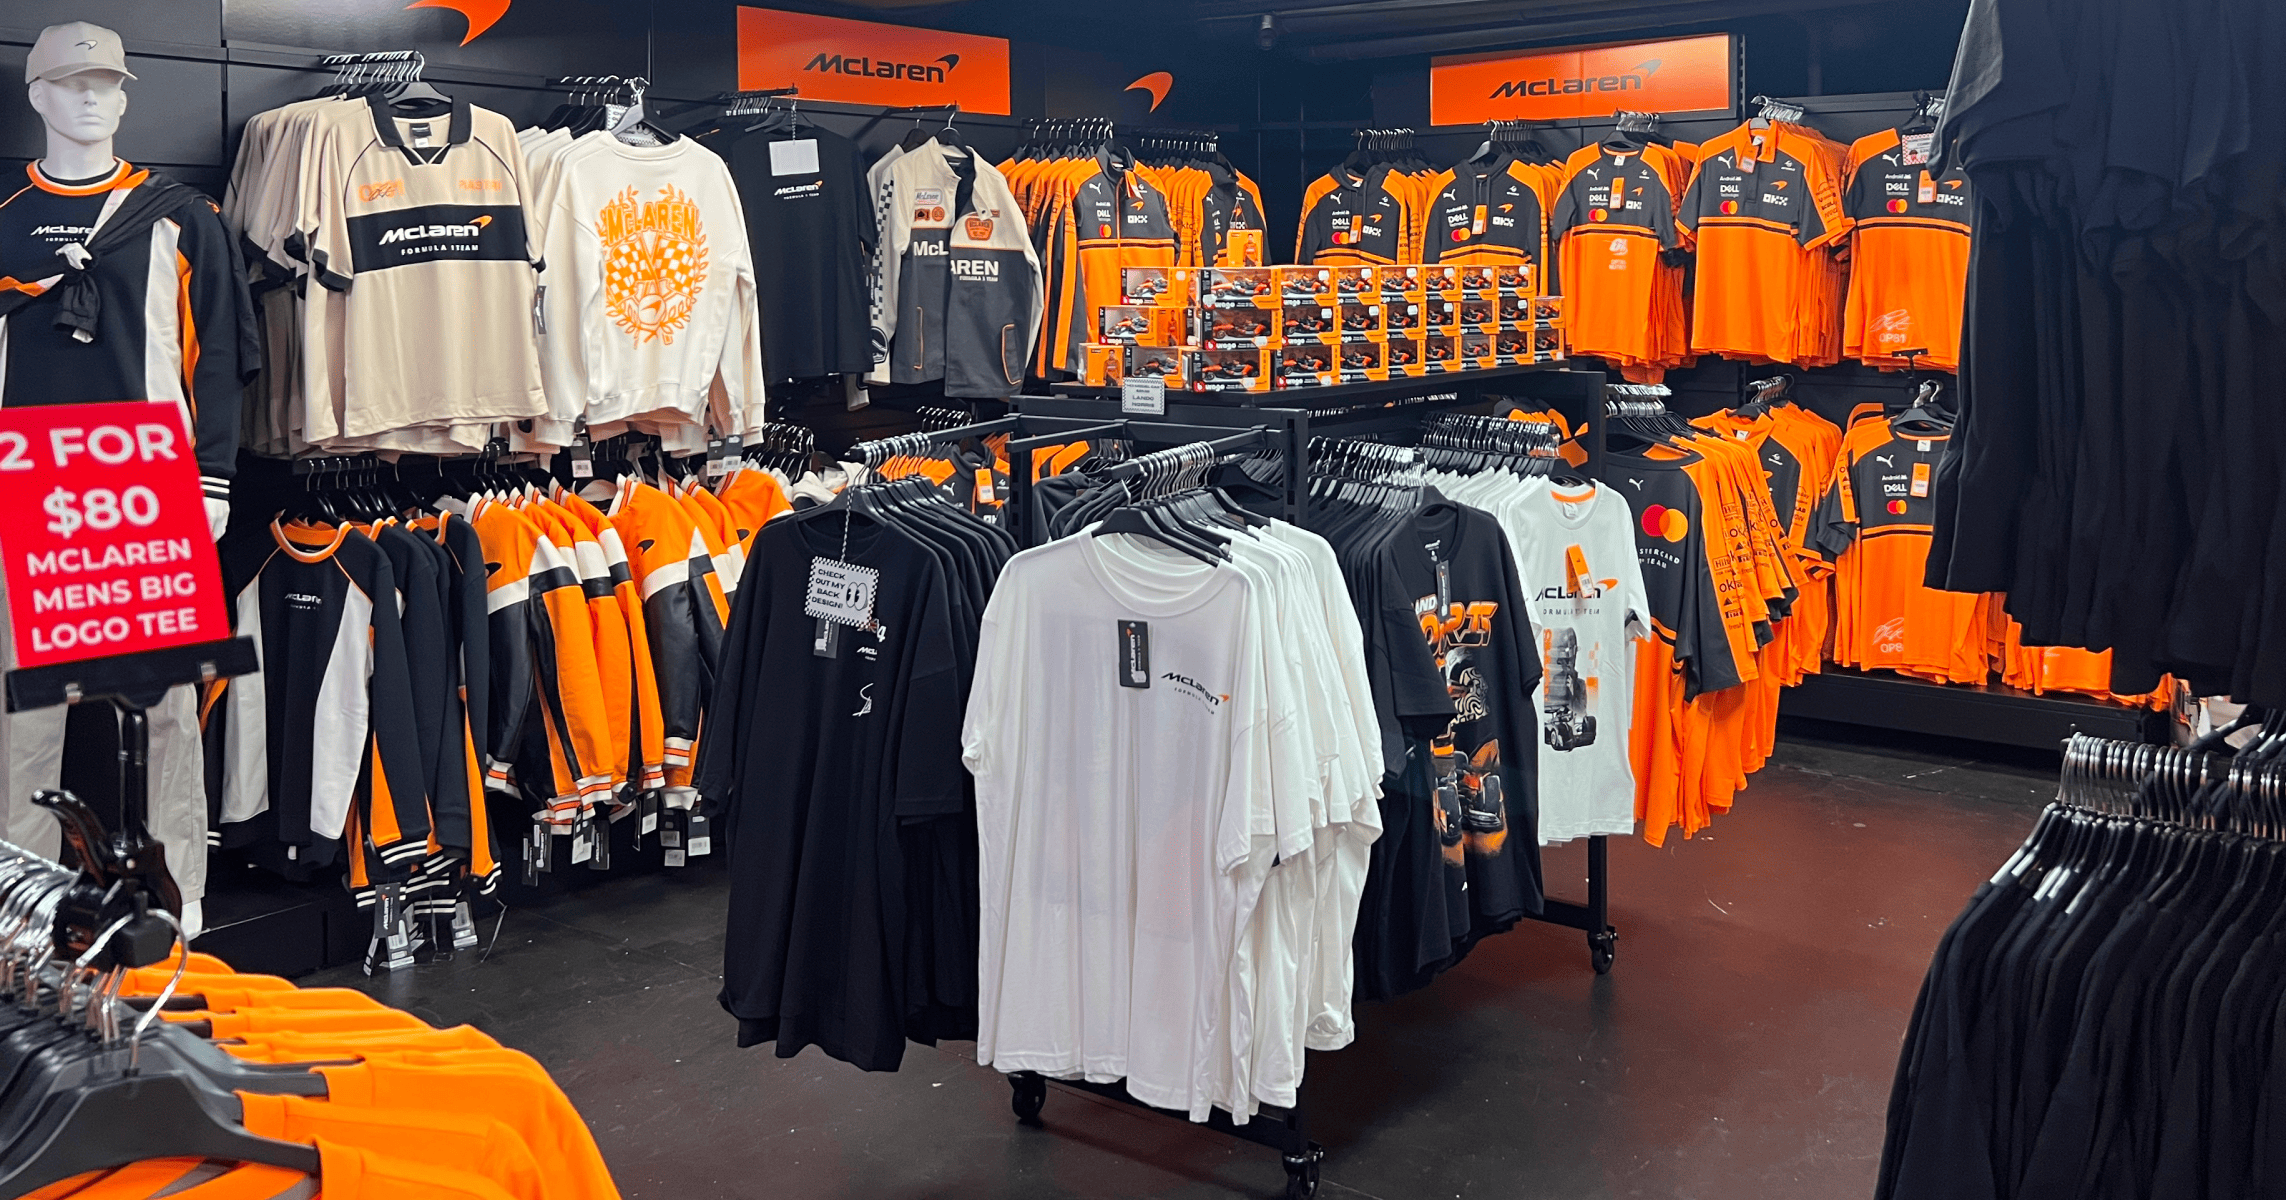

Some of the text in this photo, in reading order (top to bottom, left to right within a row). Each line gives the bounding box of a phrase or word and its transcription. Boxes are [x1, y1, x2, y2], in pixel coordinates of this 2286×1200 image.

[804, 53, 944, 83] McLaren
[1489, 74, 1642, 99] McLaren
[774, 184, 820, 196] McLaren
[1720, 185, 1740, 193] DELL
[1885, 182, 1910, 191] DELL
[1589, 194, 1609, 202] DELL
[1332, 218, 1350, 226] DELL
[1447, 213, 1469, 223] DELL
[1492, 216, 1515, 228] OKX
[379, 225, 479, 245] McLaren
[402, 244, 447, 255] FORMULA
[0, 423, 179, 471] 2 FOR
[1883, 484, 1908, 492] DELL
[43, 485, 160, 539] $80
[26, 537, 192, 577] MCLAREN
[1639, 548, 1680, 565] STERCARD
[817, 568, 846, 580] CHECK
[815, 578, 846, 590] OUT MY
[33, 572, 197, 614] MENS BIG
[817, 588, 840, 599] BACK
[811, 596, 844, 610] DESIGN!
[31, 607, 199, 653] LOGO TEE
[1161, 672, 1220, 706] McLaren
